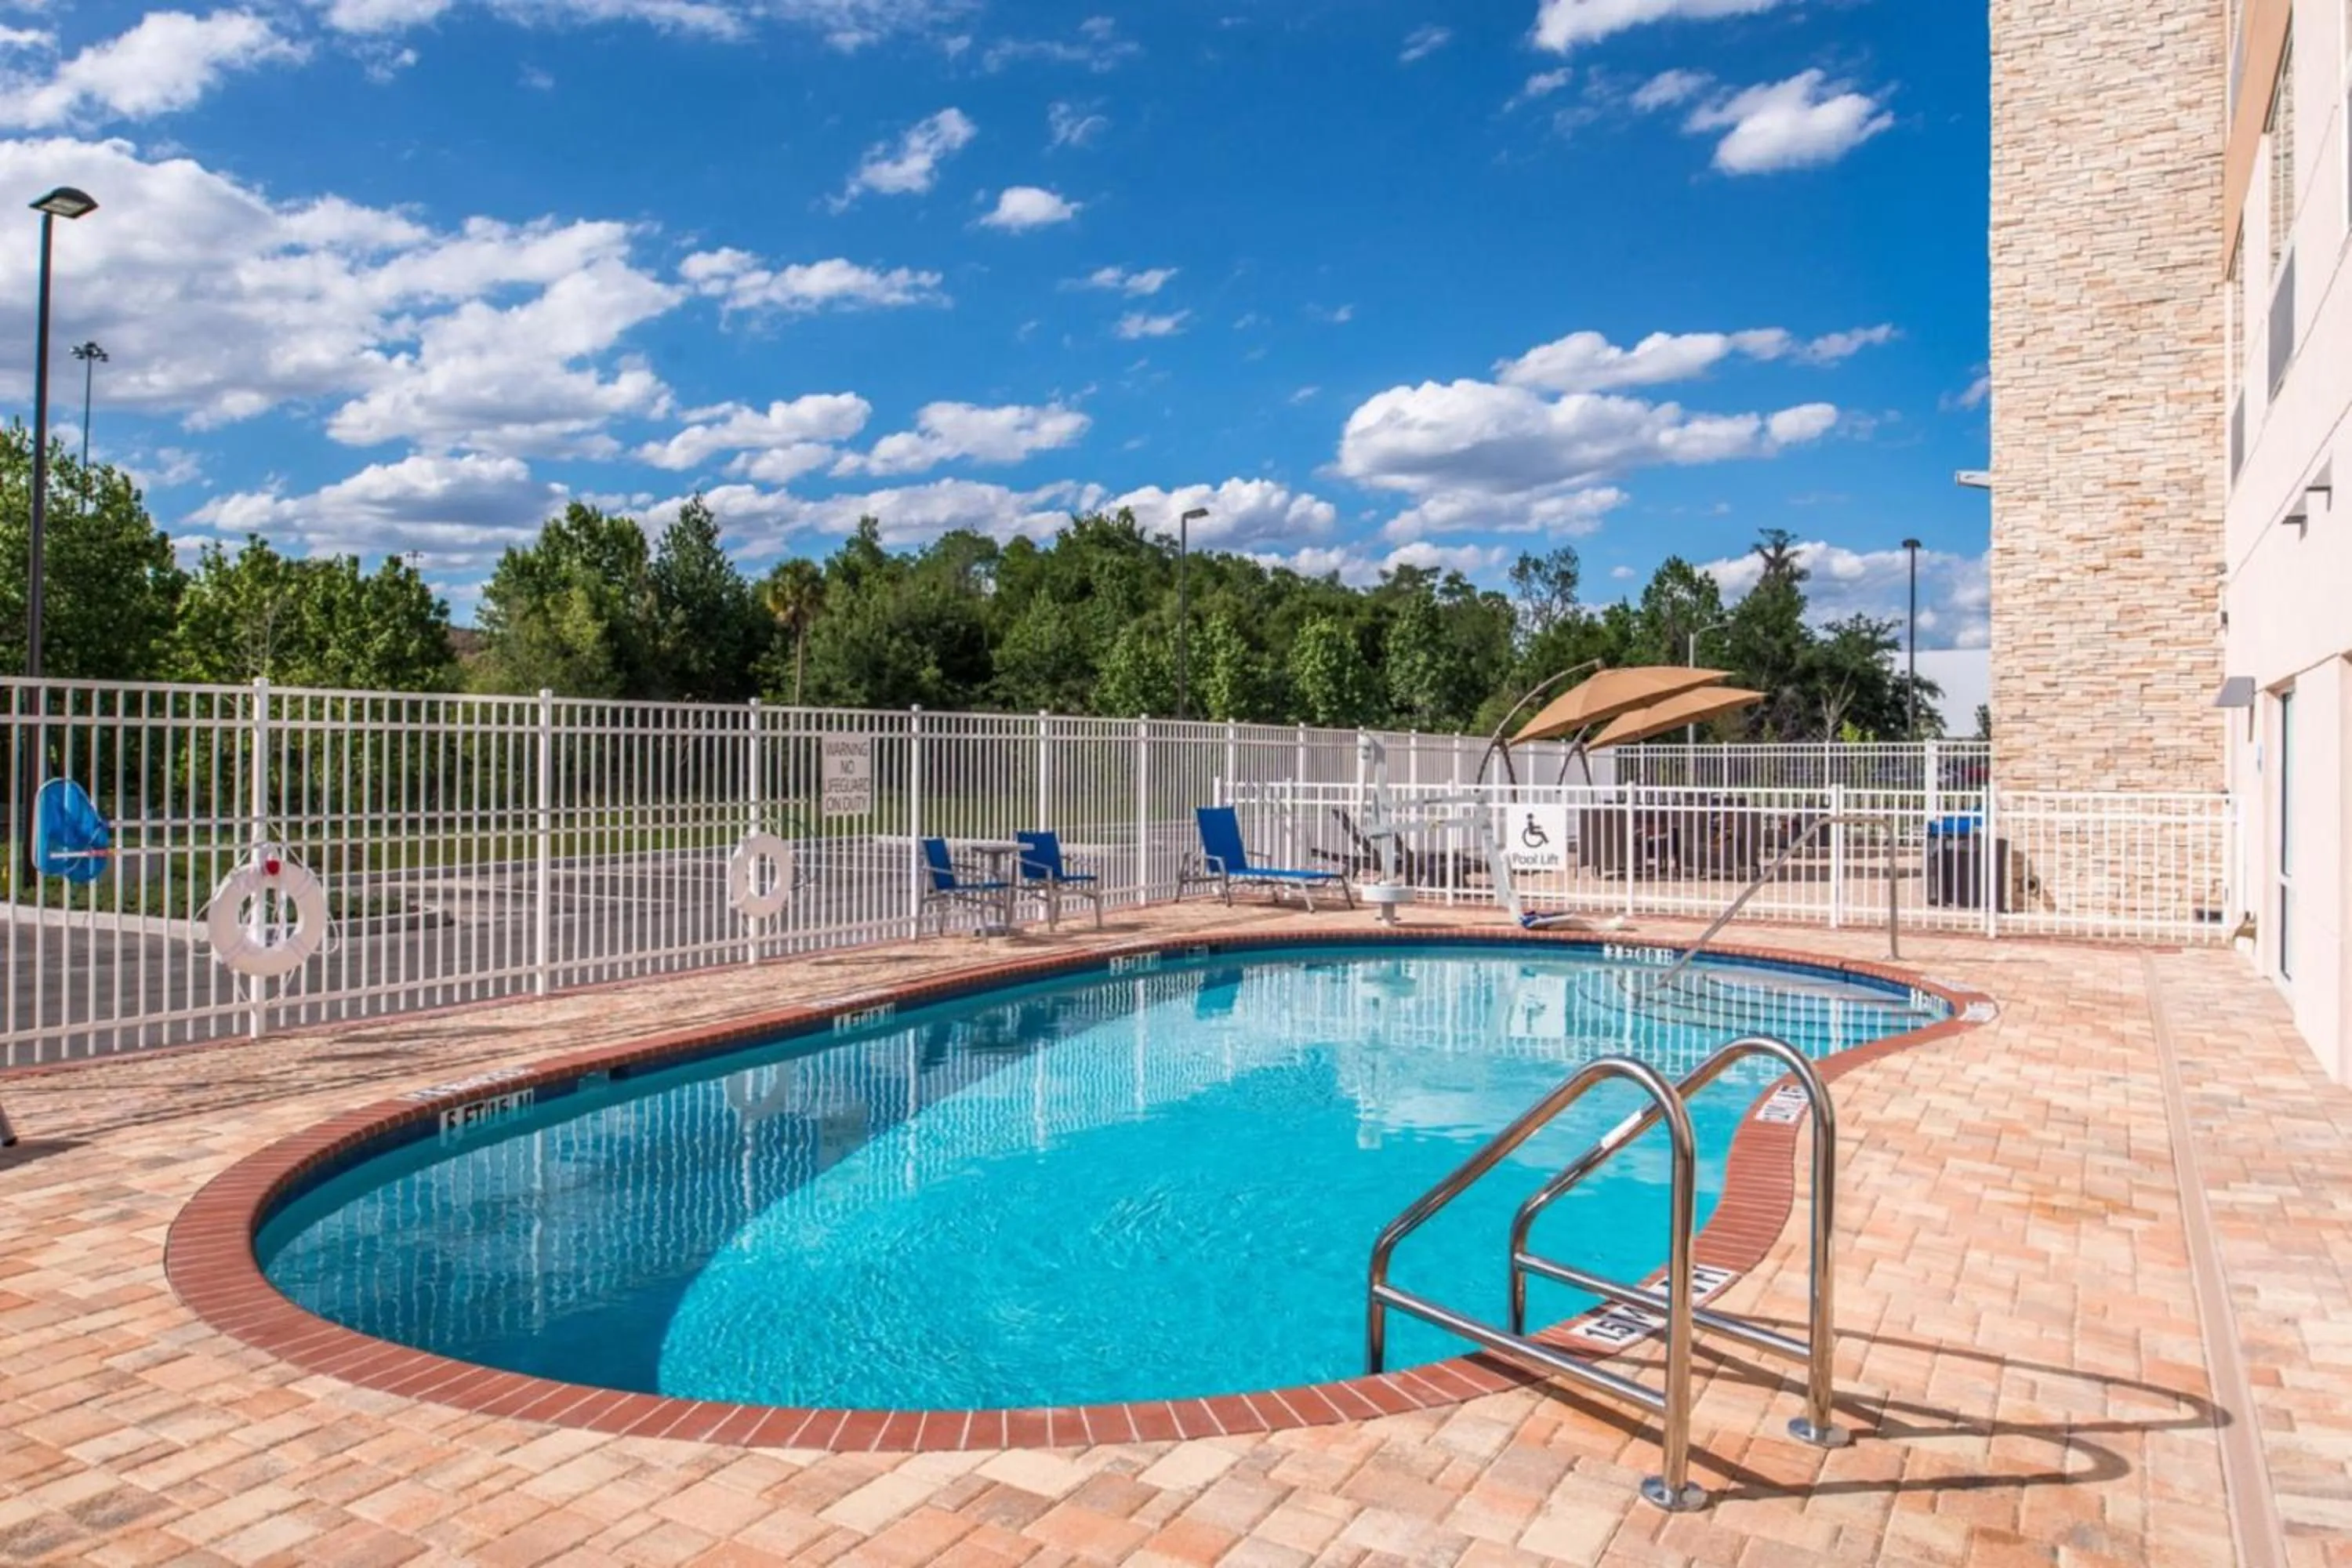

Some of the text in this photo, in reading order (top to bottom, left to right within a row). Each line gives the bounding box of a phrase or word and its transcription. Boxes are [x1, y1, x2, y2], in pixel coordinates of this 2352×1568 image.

[824, 741, 868, 757] WARNING
[840, 759, 855, 775] NO
[823, 777, 870, 793] LIFEGUARD
[826, 796, 868, 811] ON DUTY
[1512, 852, 1559, 866] Pool Lift
